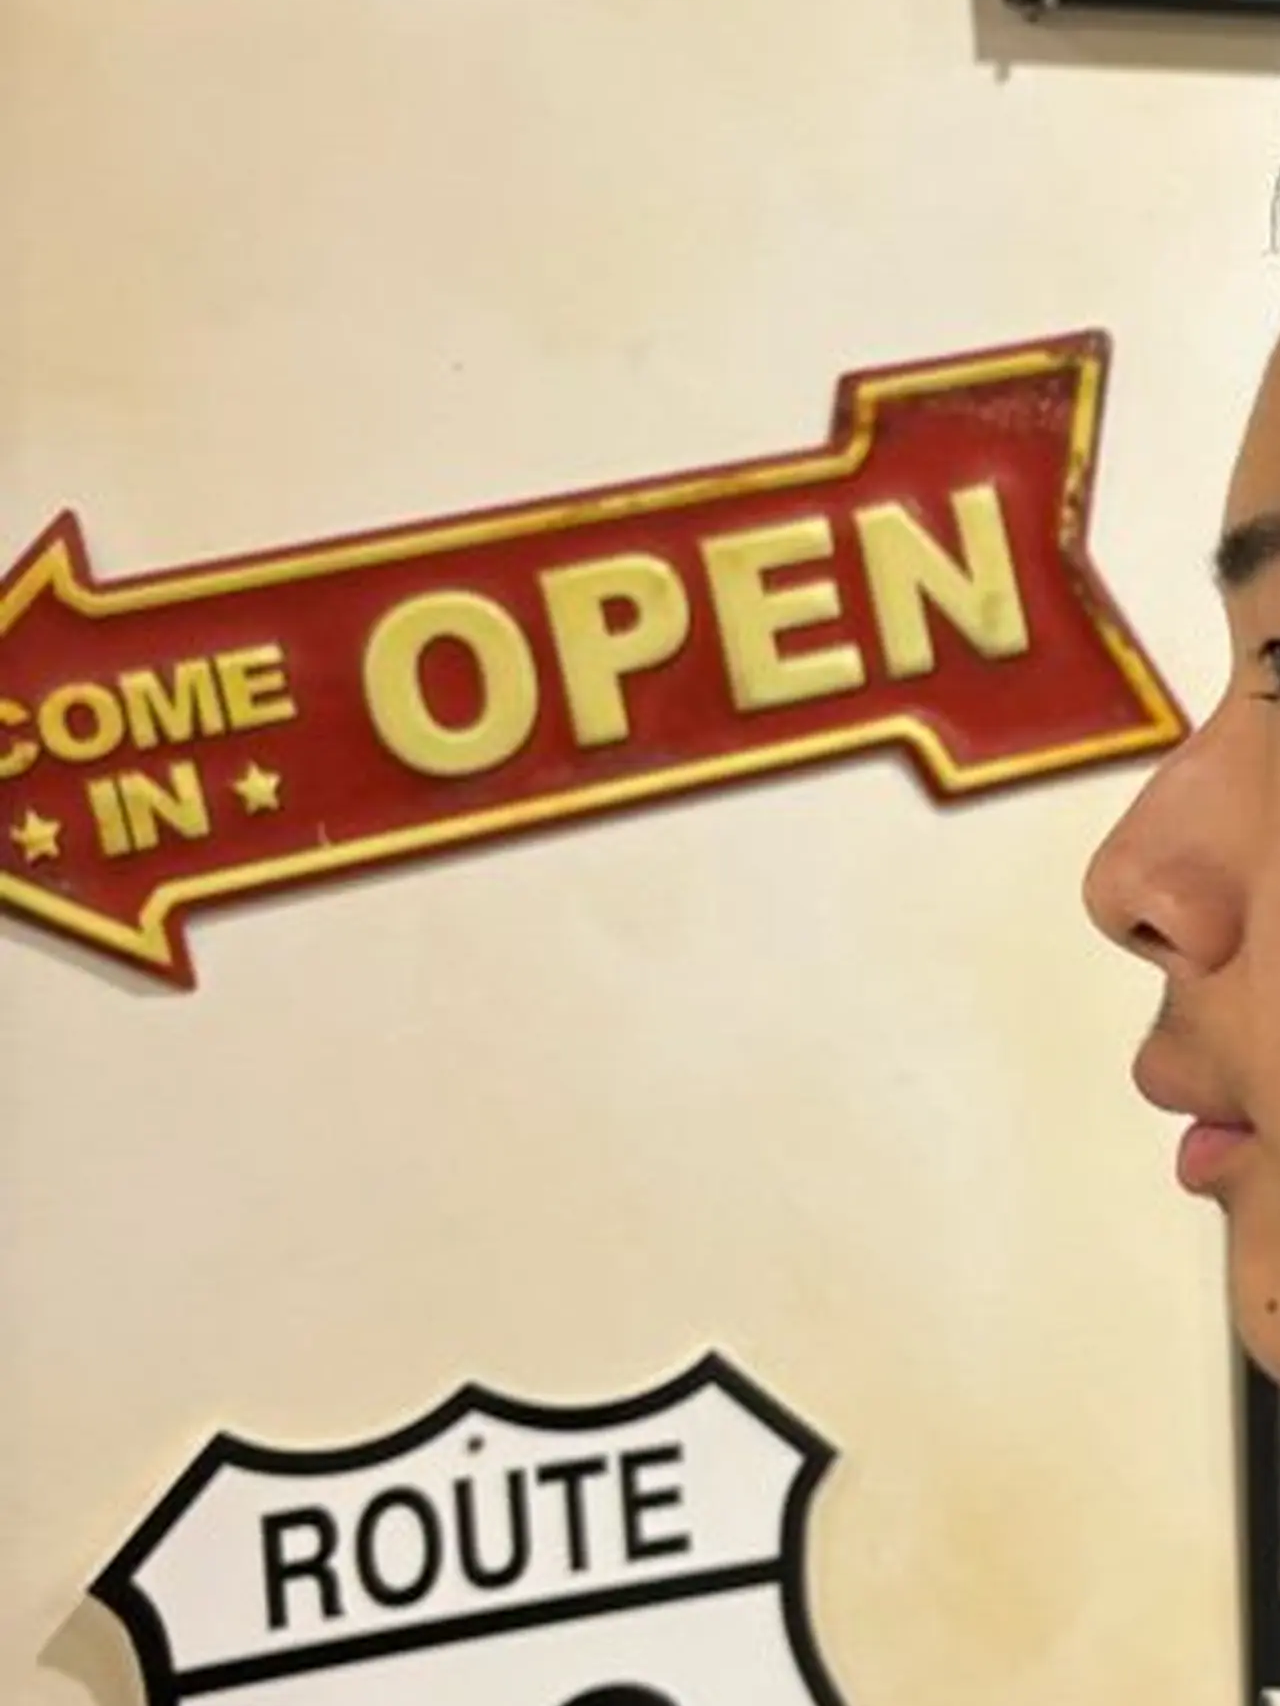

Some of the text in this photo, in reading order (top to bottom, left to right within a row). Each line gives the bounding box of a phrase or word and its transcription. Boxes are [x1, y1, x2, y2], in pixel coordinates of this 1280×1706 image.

[361, 482, 1031, 778] OPEN
[87, 759, 210, 857] IN
[259, 1442, 692, 1631] ROUTE
